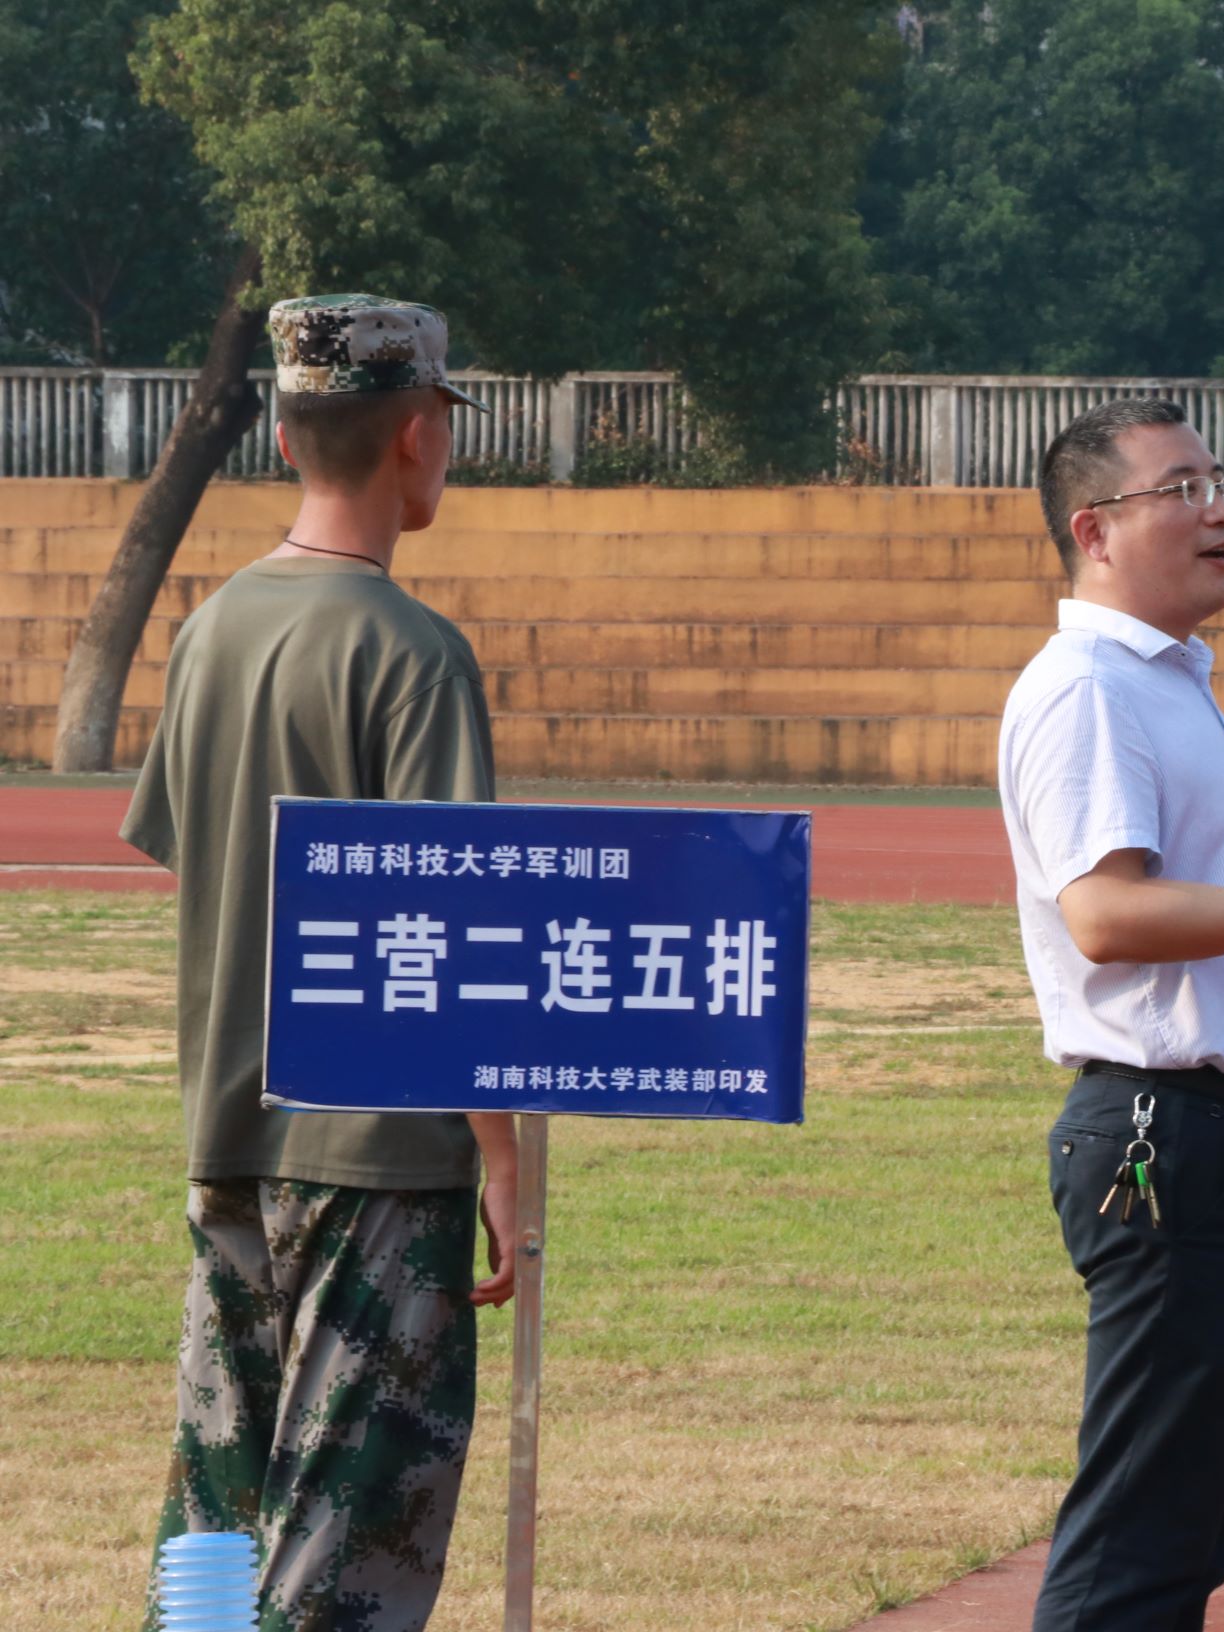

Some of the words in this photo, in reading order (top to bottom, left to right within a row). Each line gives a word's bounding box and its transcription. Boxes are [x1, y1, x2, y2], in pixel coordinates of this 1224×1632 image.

[306, 842, 631, 880] 湖南科技大学军训团
[291, 912, 777, 1017] 三营二连五排
[473, 1065, 769, 1094] 湖南科技大学武装部印发
